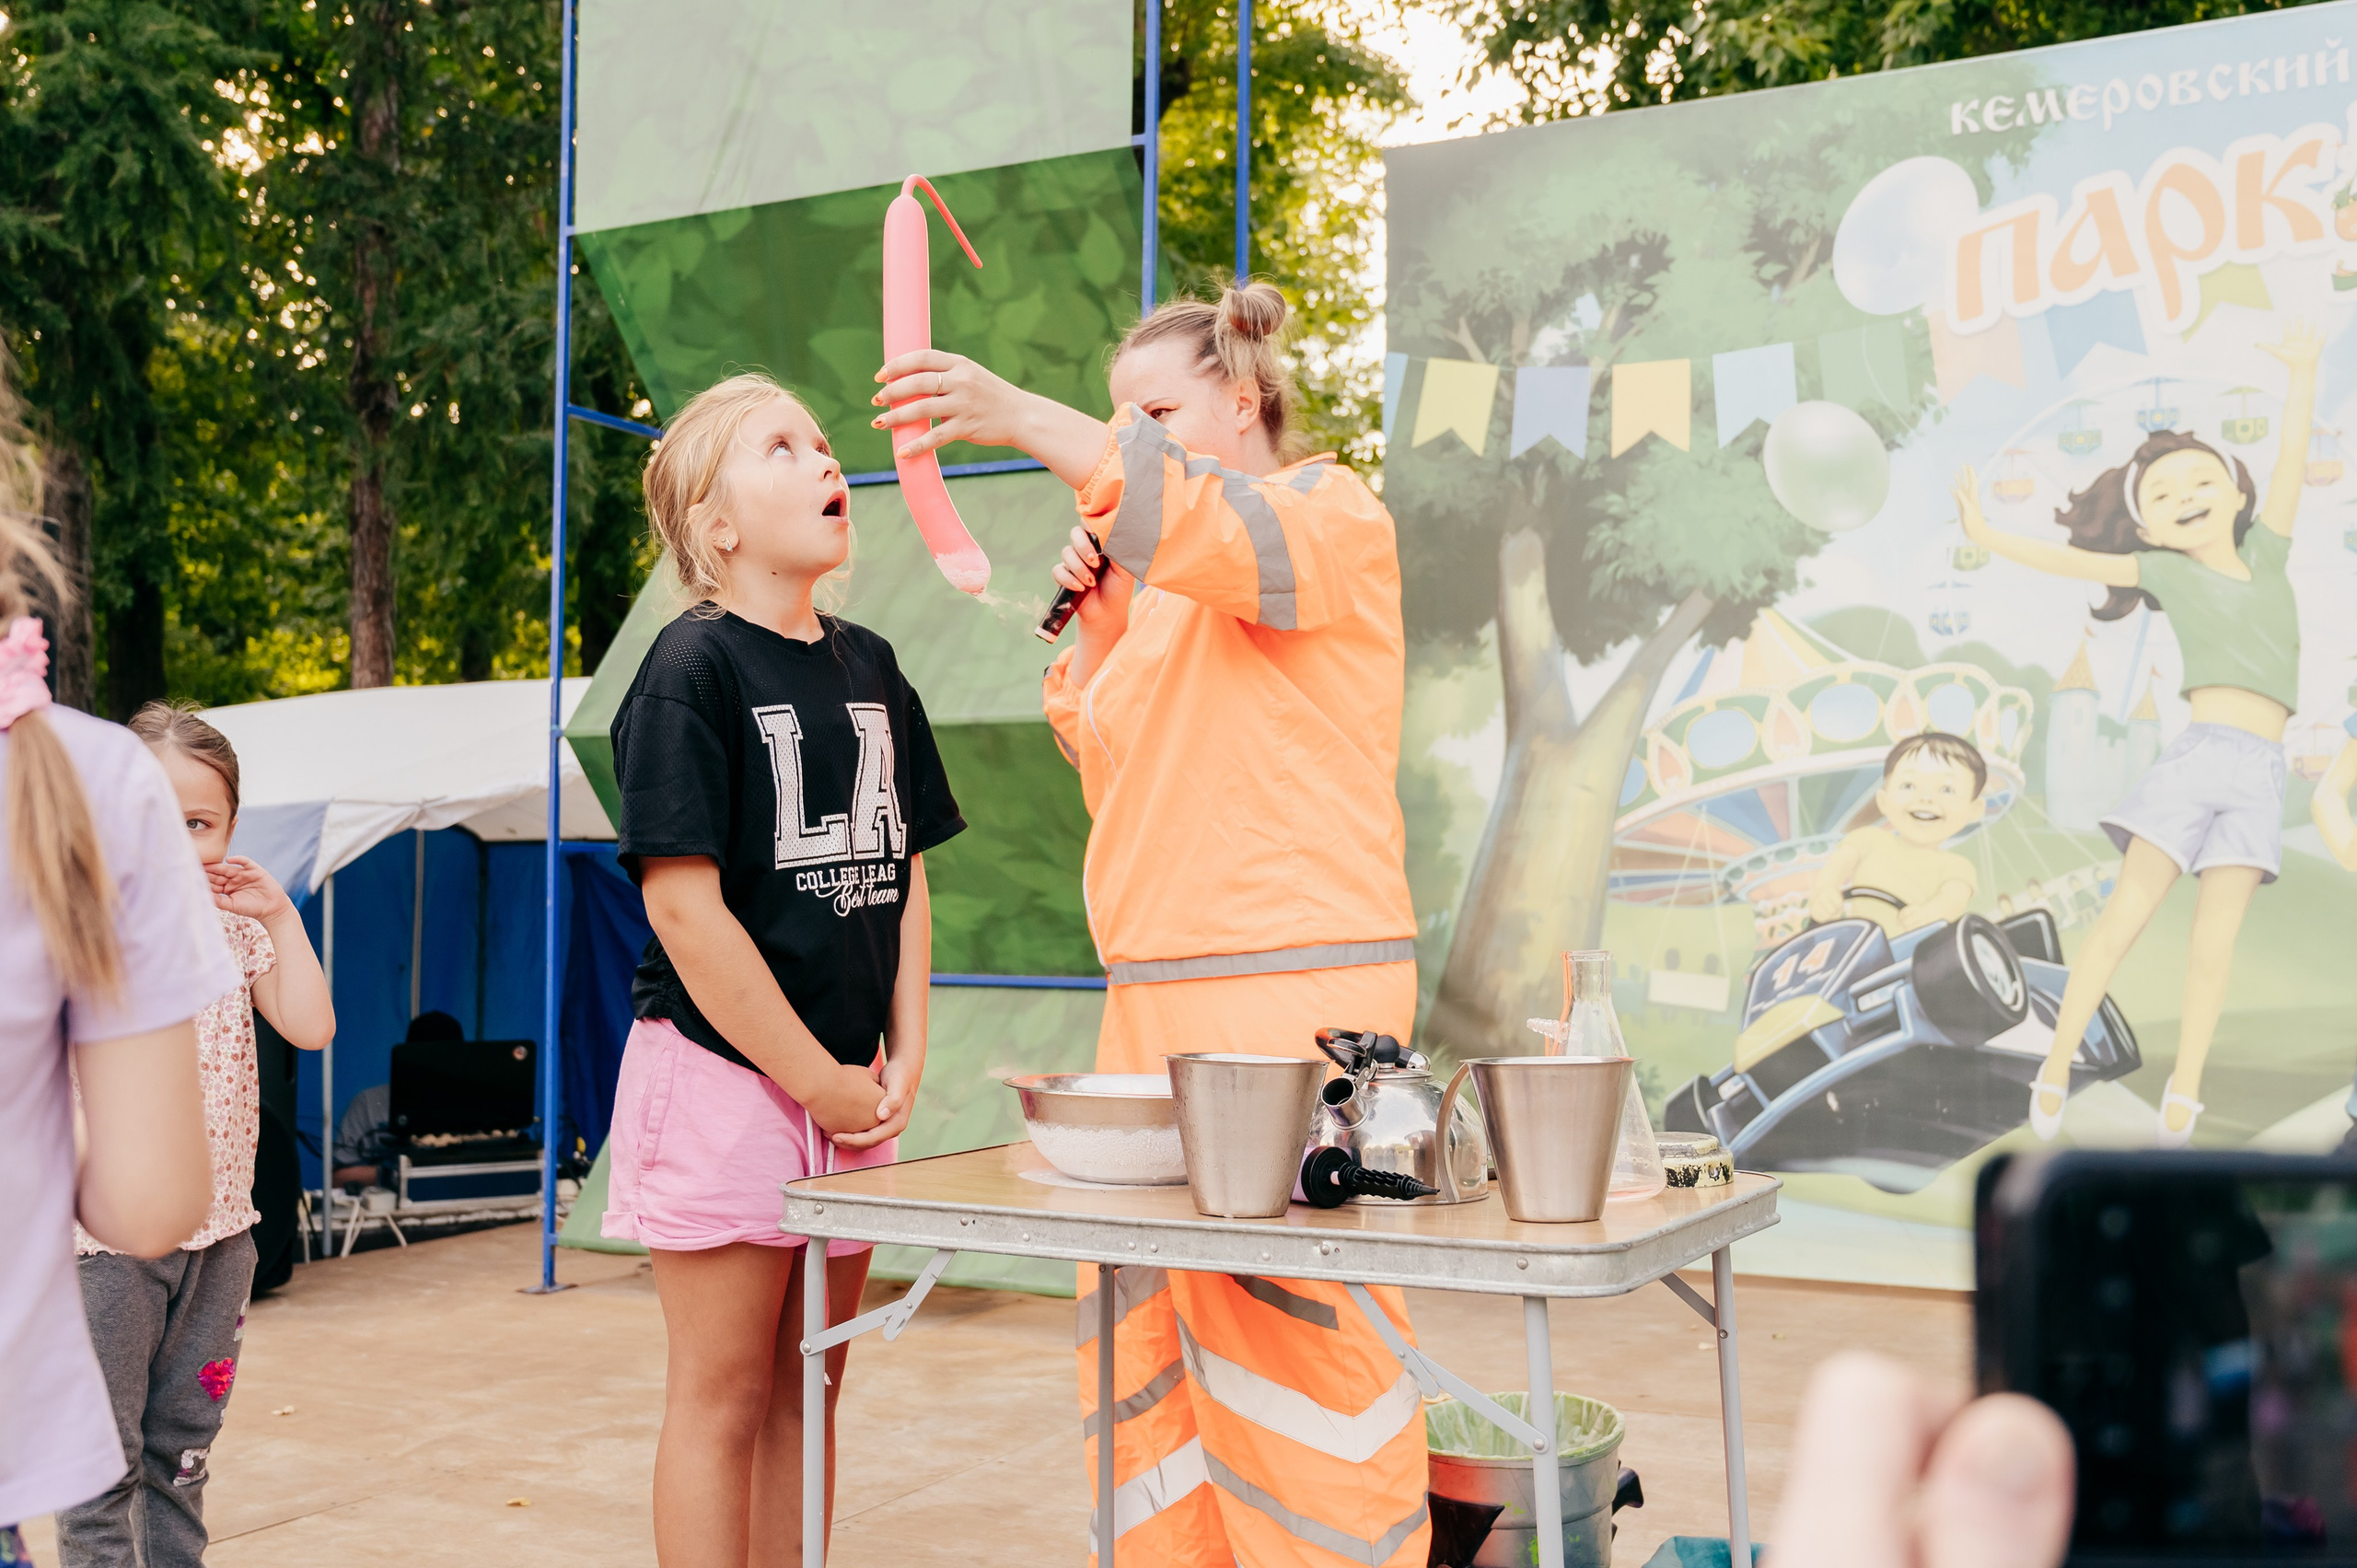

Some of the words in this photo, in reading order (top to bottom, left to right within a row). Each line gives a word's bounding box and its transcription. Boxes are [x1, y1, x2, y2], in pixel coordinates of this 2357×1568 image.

[1953, 138, 2327, 323] парк
[750, 702, 908, 871] LA
[795, 865, 860, 891] COLLEGE
[862, 863, 896, 886] LEAG
[815, 882, 866, 917] Best
[866, 881, 900, 906] team
